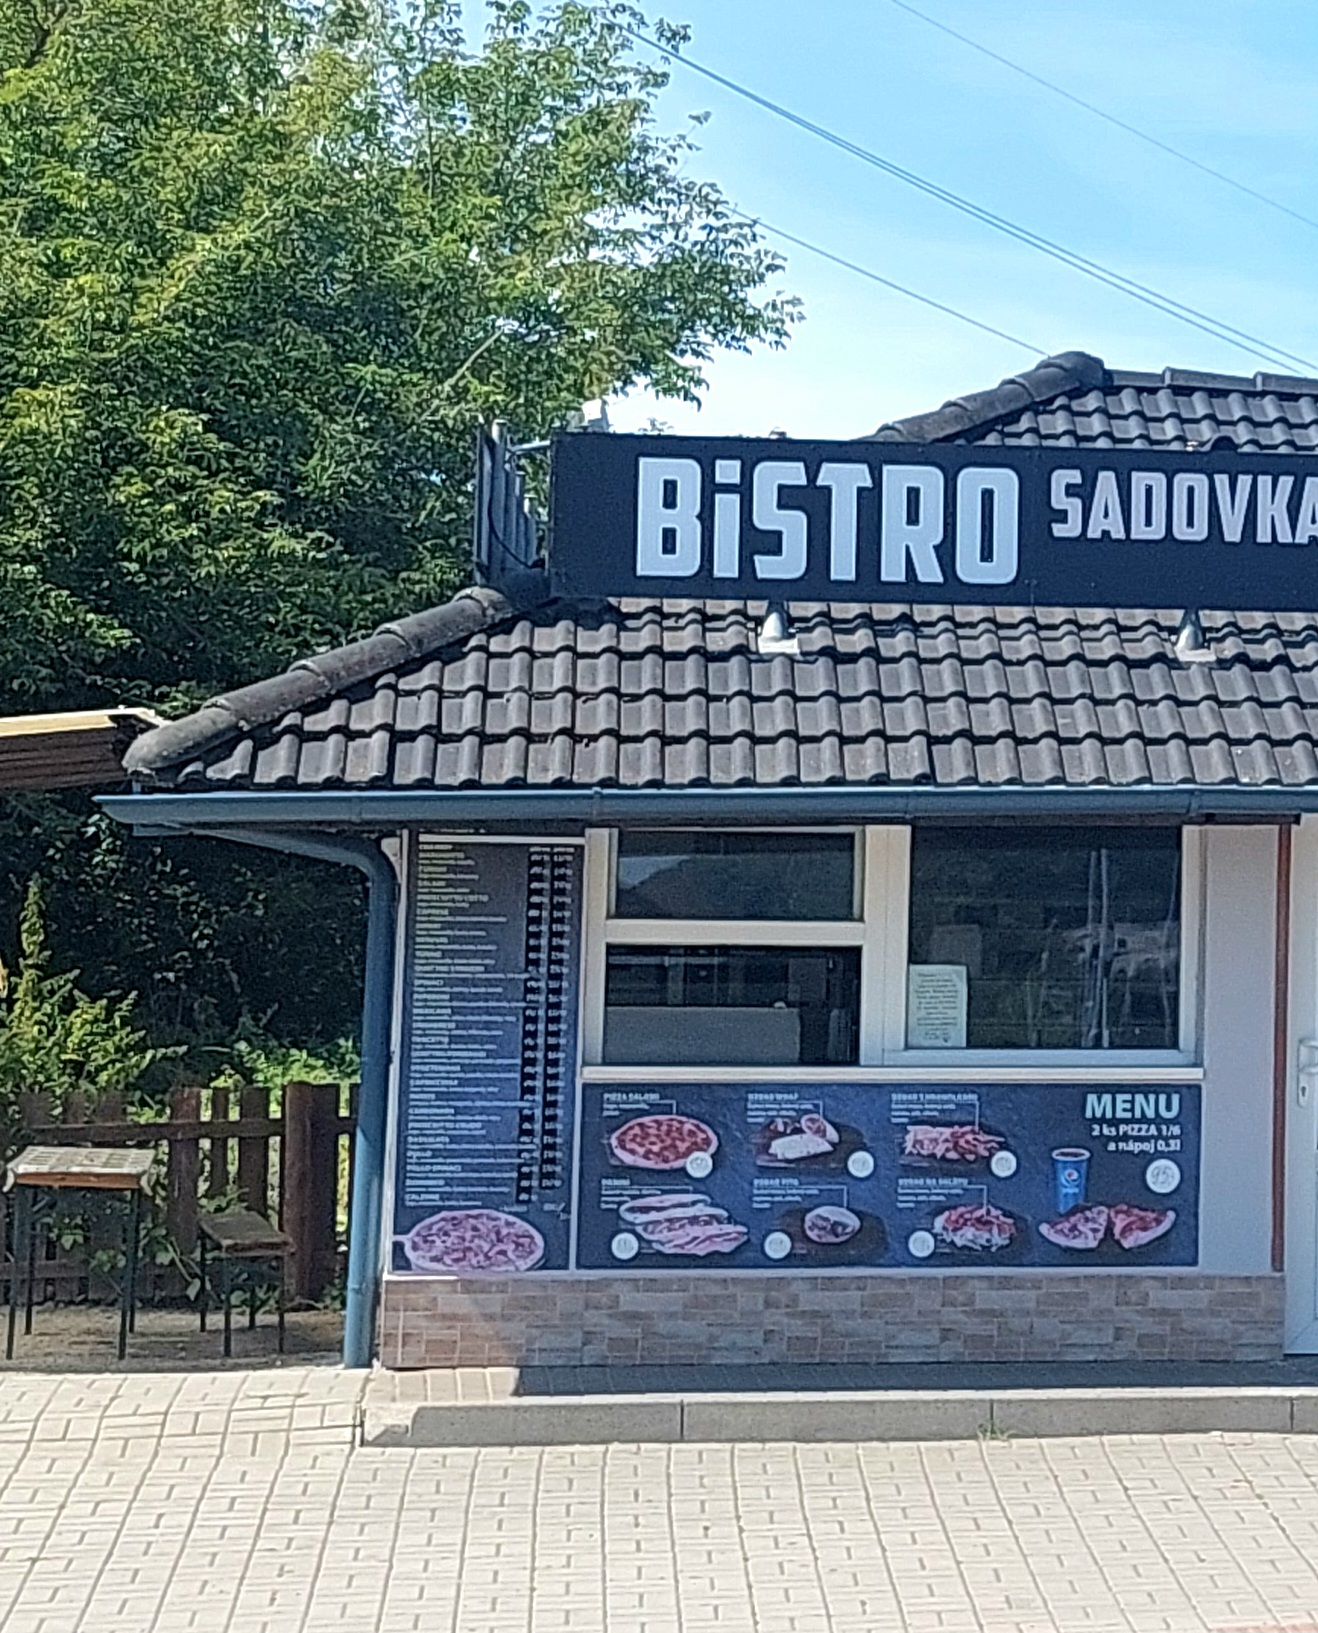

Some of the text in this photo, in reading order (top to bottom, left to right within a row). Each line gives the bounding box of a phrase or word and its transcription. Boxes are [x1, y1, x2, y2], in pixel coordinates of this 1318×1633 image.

[1085, 1093, 1180, 1119] MENU
[1091, 1124, 1101, 1136] 2
[1119, 1124, 1158, 1136] PIZZA
[1107, 1142, 1117, 1151] a
[1118, 1139, 1155, 1154] nápoj
